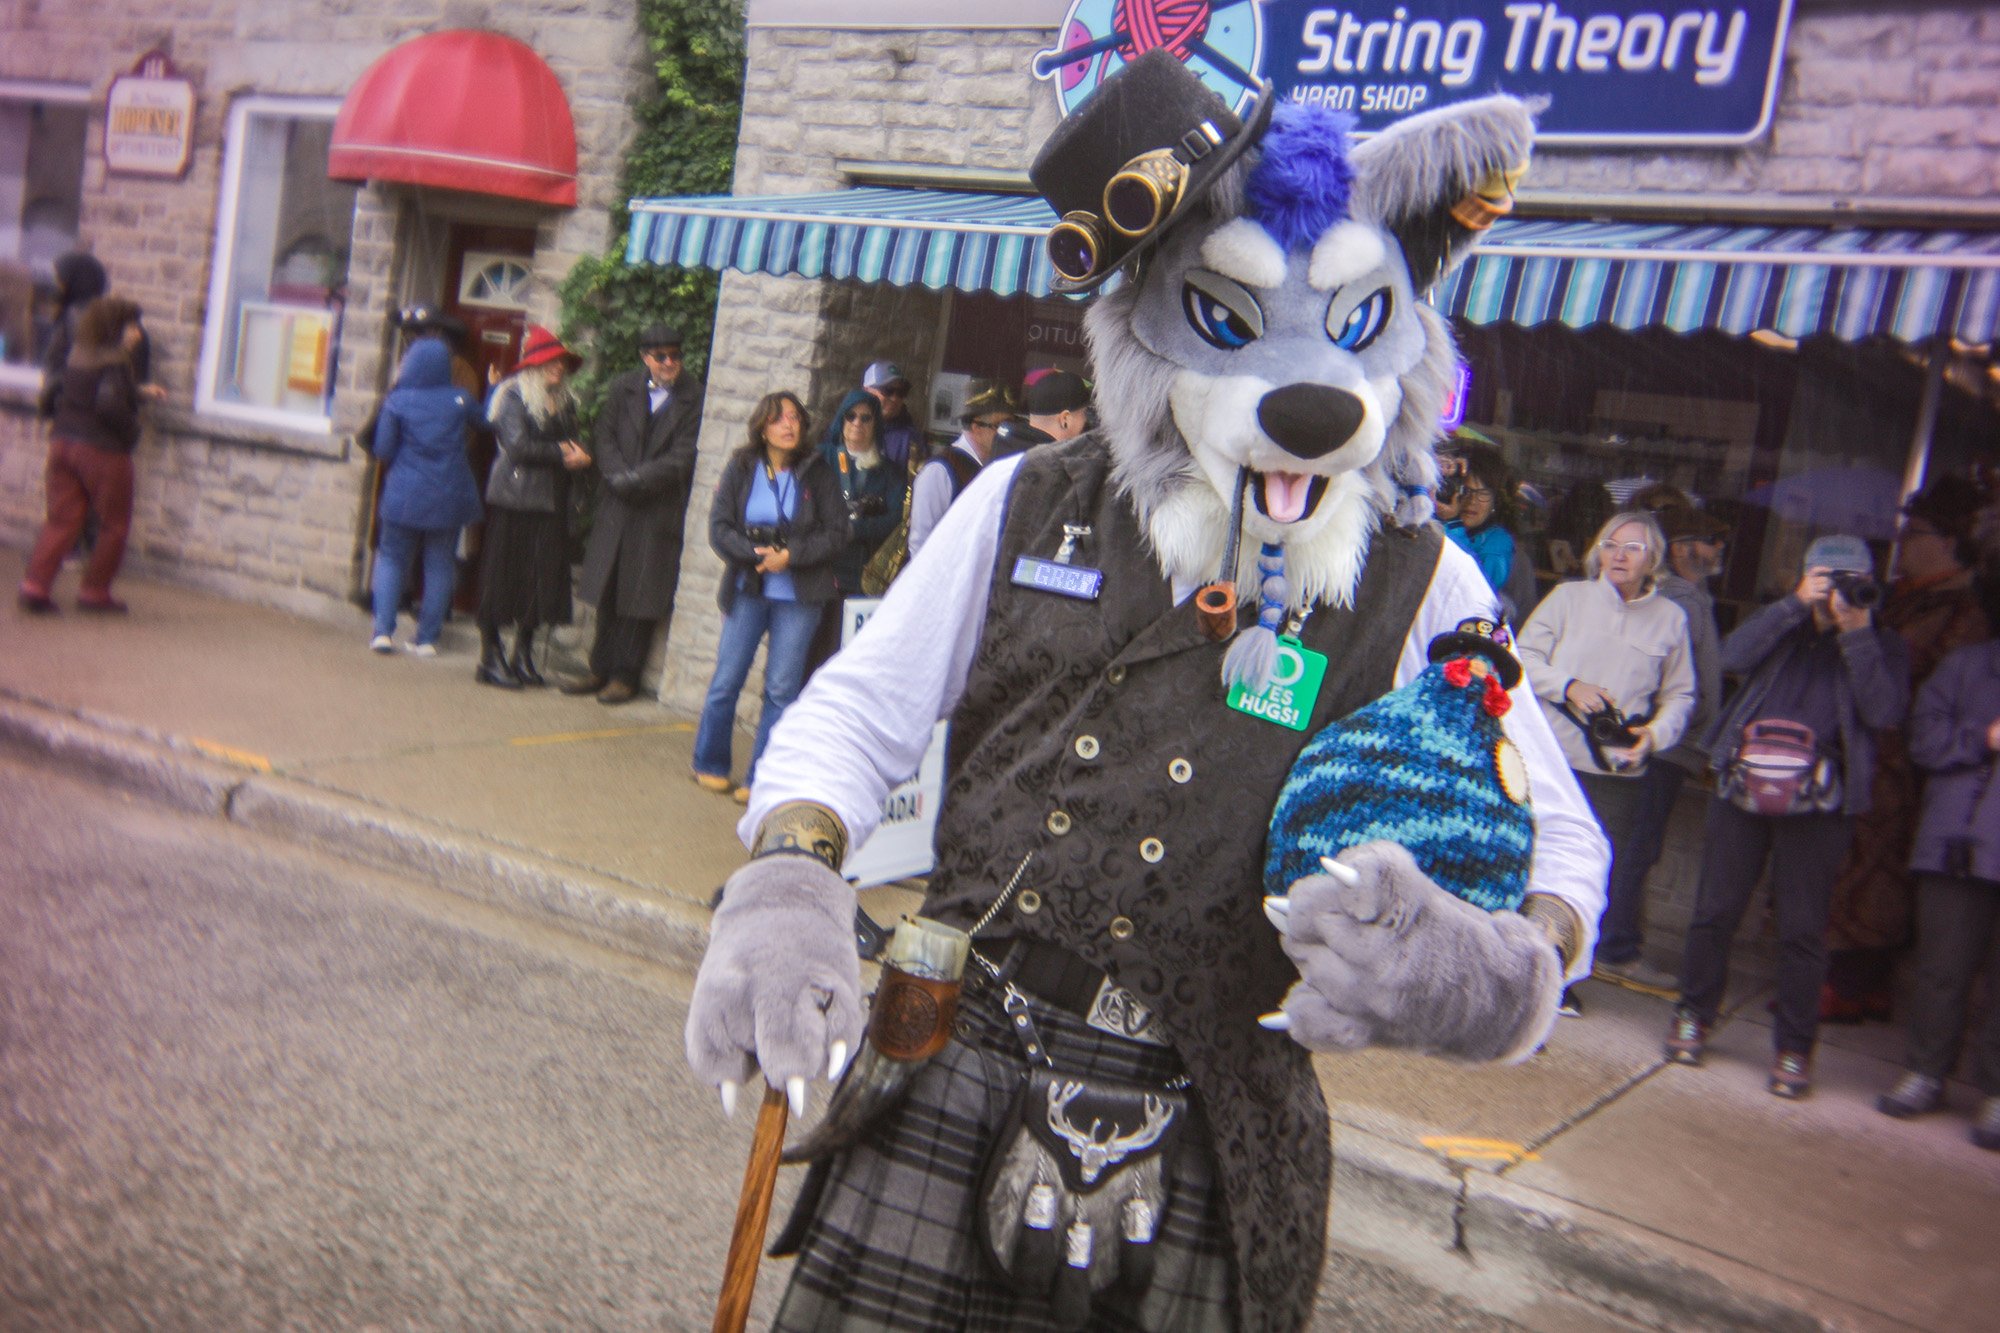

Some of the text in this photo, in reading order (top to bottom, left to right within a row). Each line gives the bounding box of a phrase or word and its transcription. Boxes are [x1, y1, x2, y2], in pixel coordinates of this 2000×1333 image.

[1297, 2, 1748, 86] String Theory
[1291, 84, 1428, 112] YARN SHOP
[1238, 691, 1300, 726] HUGS!
